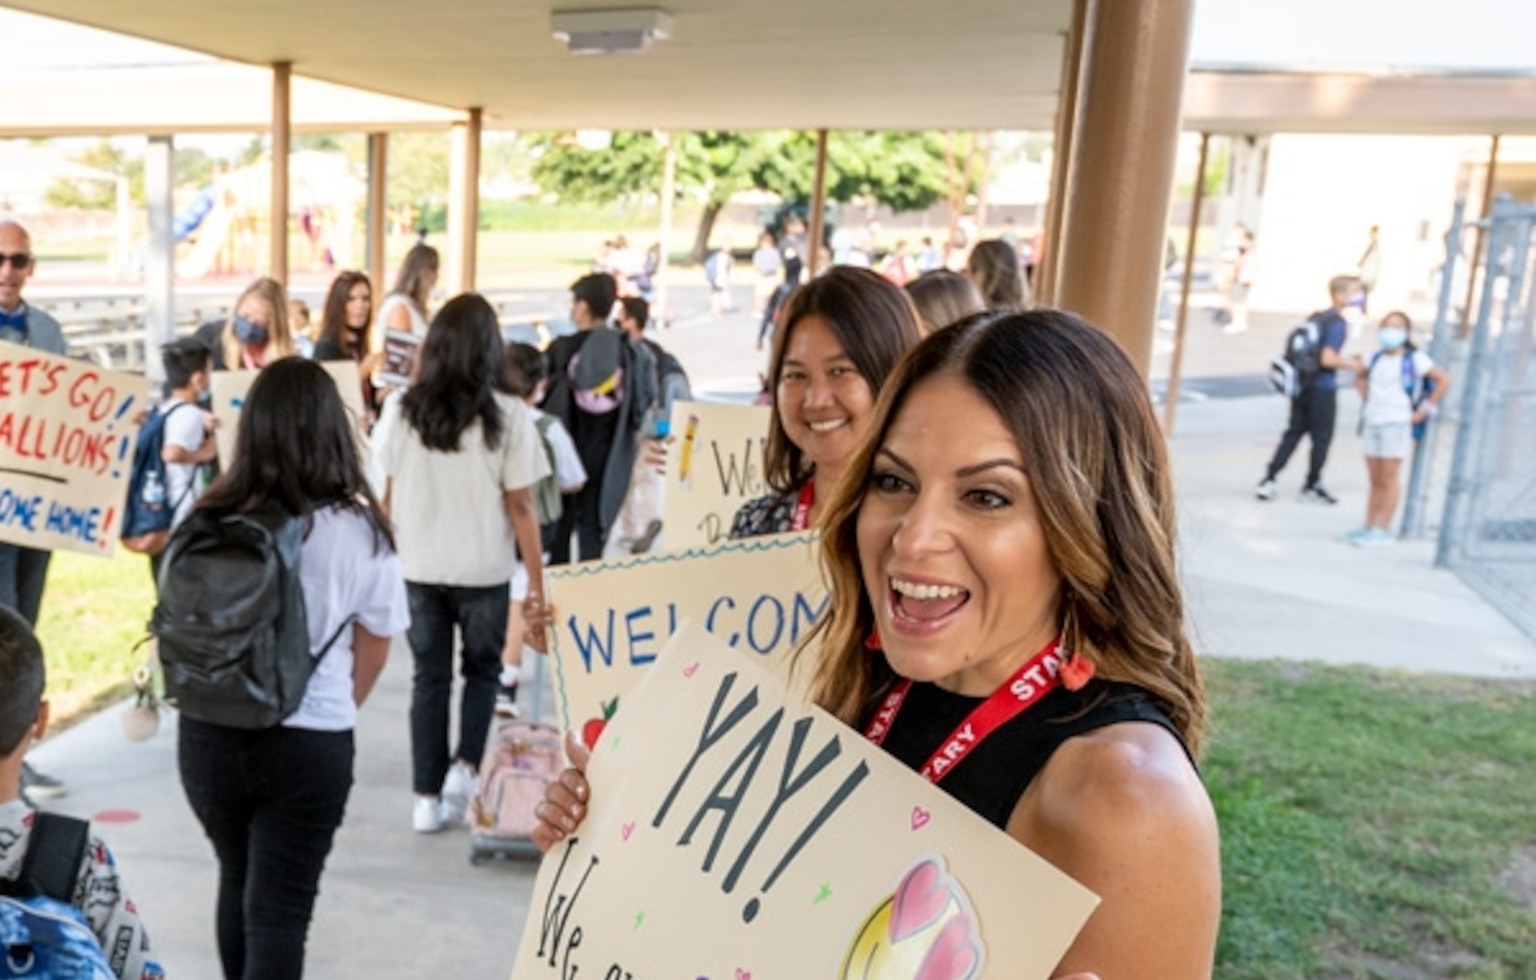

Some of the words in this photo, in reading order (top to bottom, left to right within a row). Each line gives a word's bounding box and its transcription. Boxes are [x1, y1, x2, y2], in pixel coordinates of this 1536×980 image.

[69, 372, 134, 431] GO!
[46, 501, 115, 548] HOME!
[652, 672, 870, 924] YAY!
